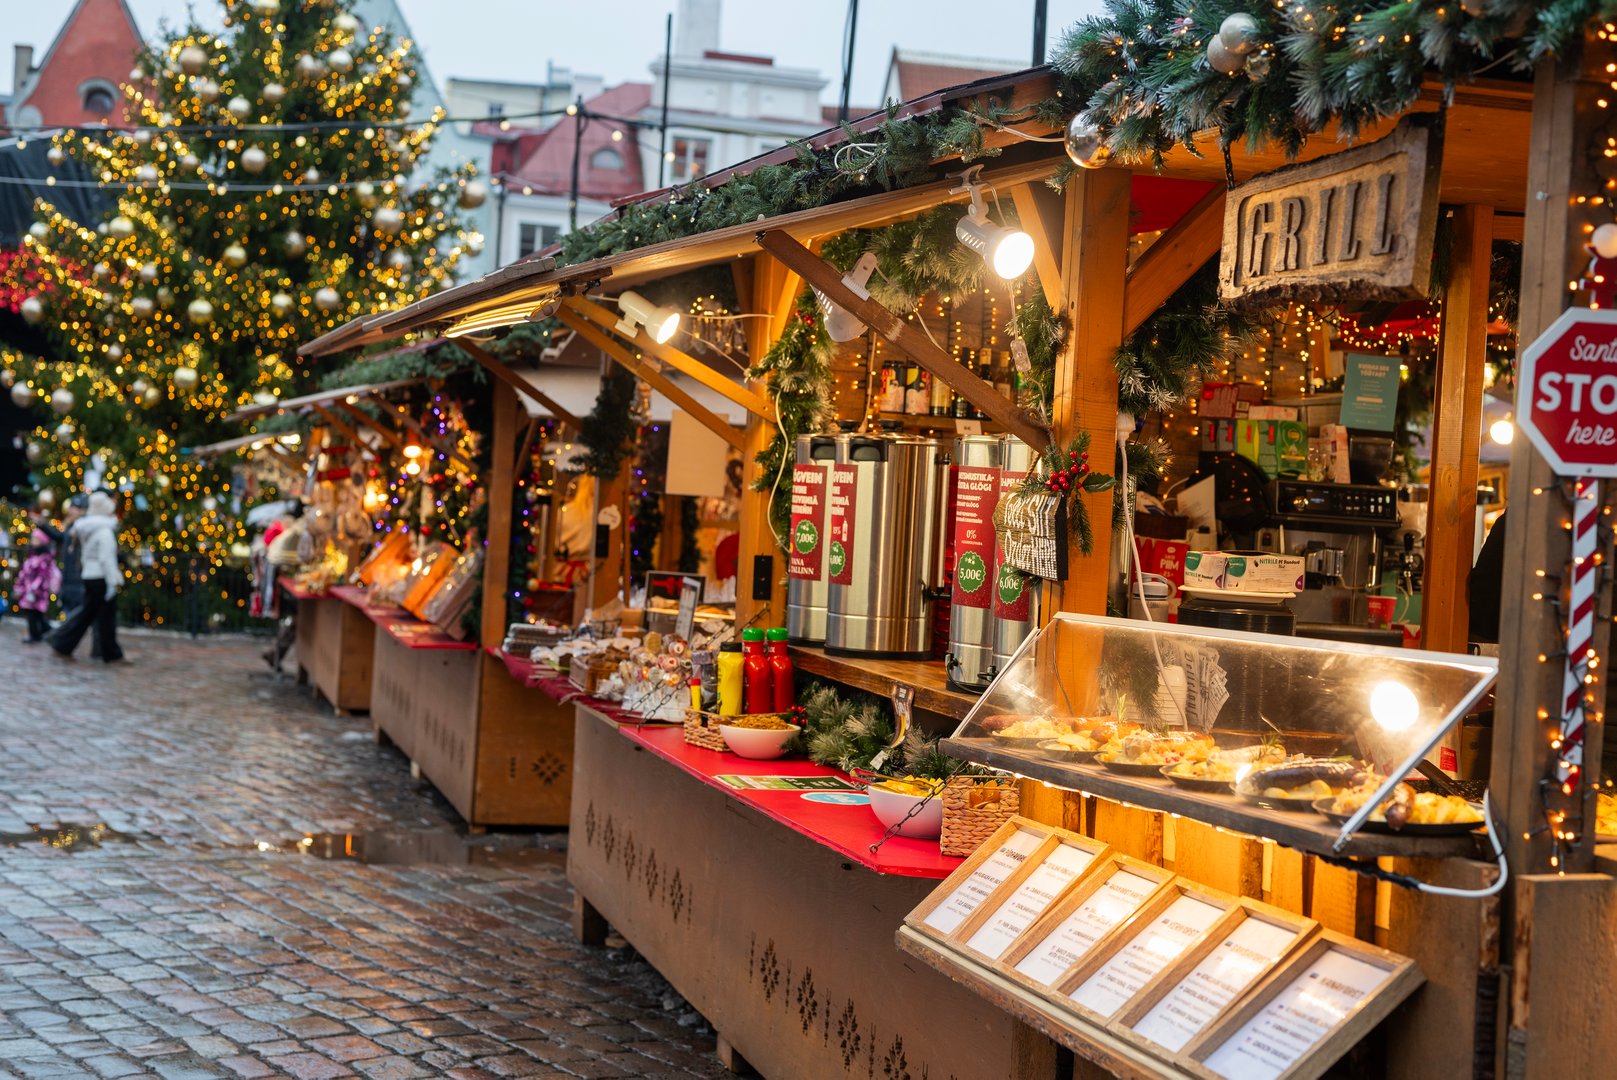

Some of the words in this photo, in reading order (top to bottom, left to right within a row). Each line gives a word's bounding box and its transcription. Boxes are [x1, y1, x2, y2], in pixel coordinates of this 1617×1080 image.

[1243, 171, 1393, 277] GRILL
[1569, 334, 1617, 363] Sant
[1535, 371, 1617, 415] STO
[1565, 418, 1616, 446] here
[796, 532, 815, 544] 7,00€
[966, 530, 977, 540] 0%
[959, 568, 982, 581] 5,00€
[999, 576, 1020, 590] 6,00€
